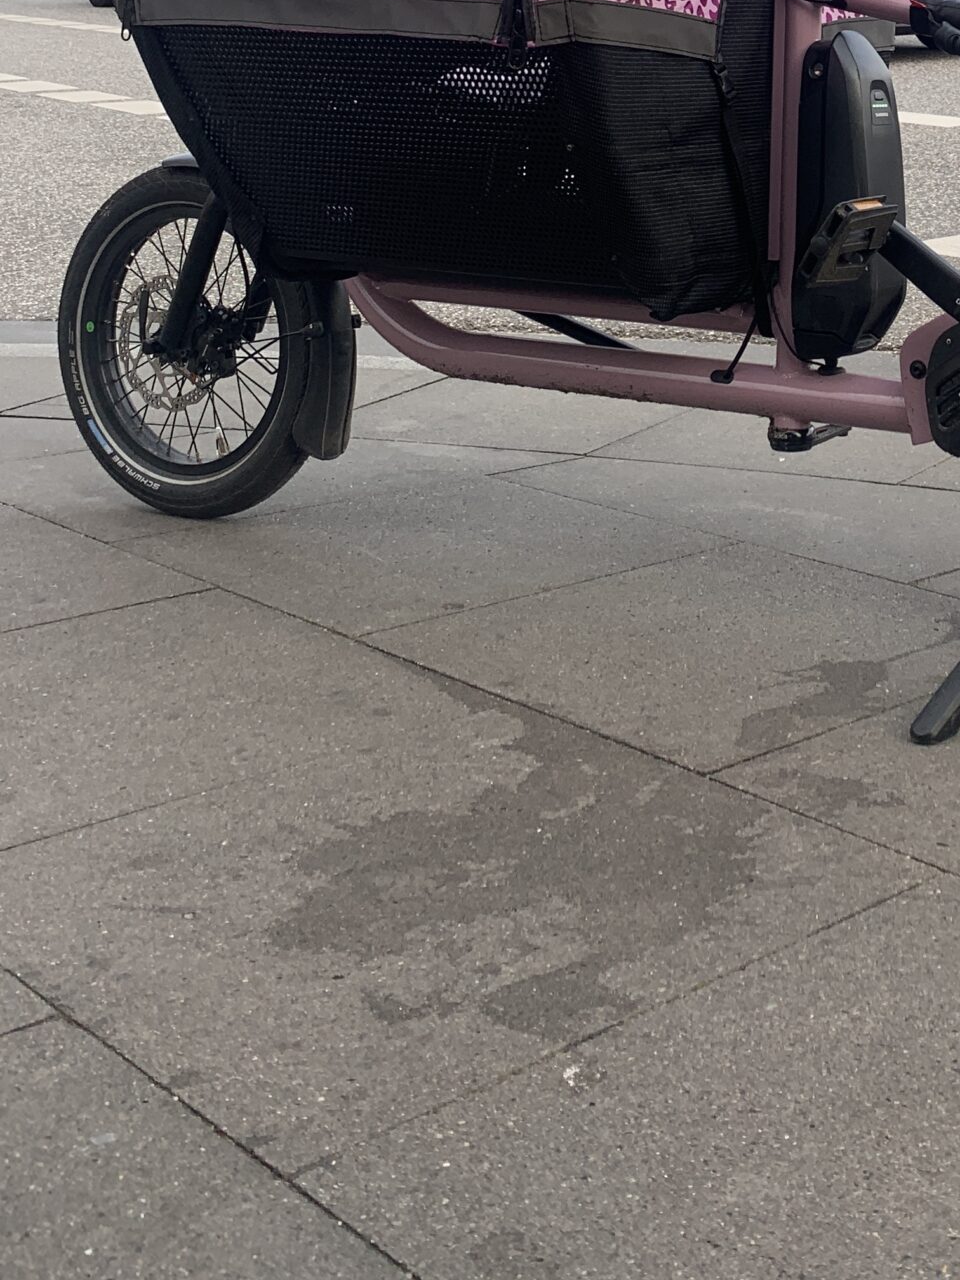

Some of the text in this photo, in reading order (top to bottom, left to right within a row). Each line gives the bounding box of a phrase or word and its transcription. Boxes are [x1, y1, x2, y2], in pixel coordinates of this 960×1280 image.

[69, 349, 82, 392] APPLE
[77, 394, 90, 416] BIG
[111, 453, 161, 491] SCHWALBE
